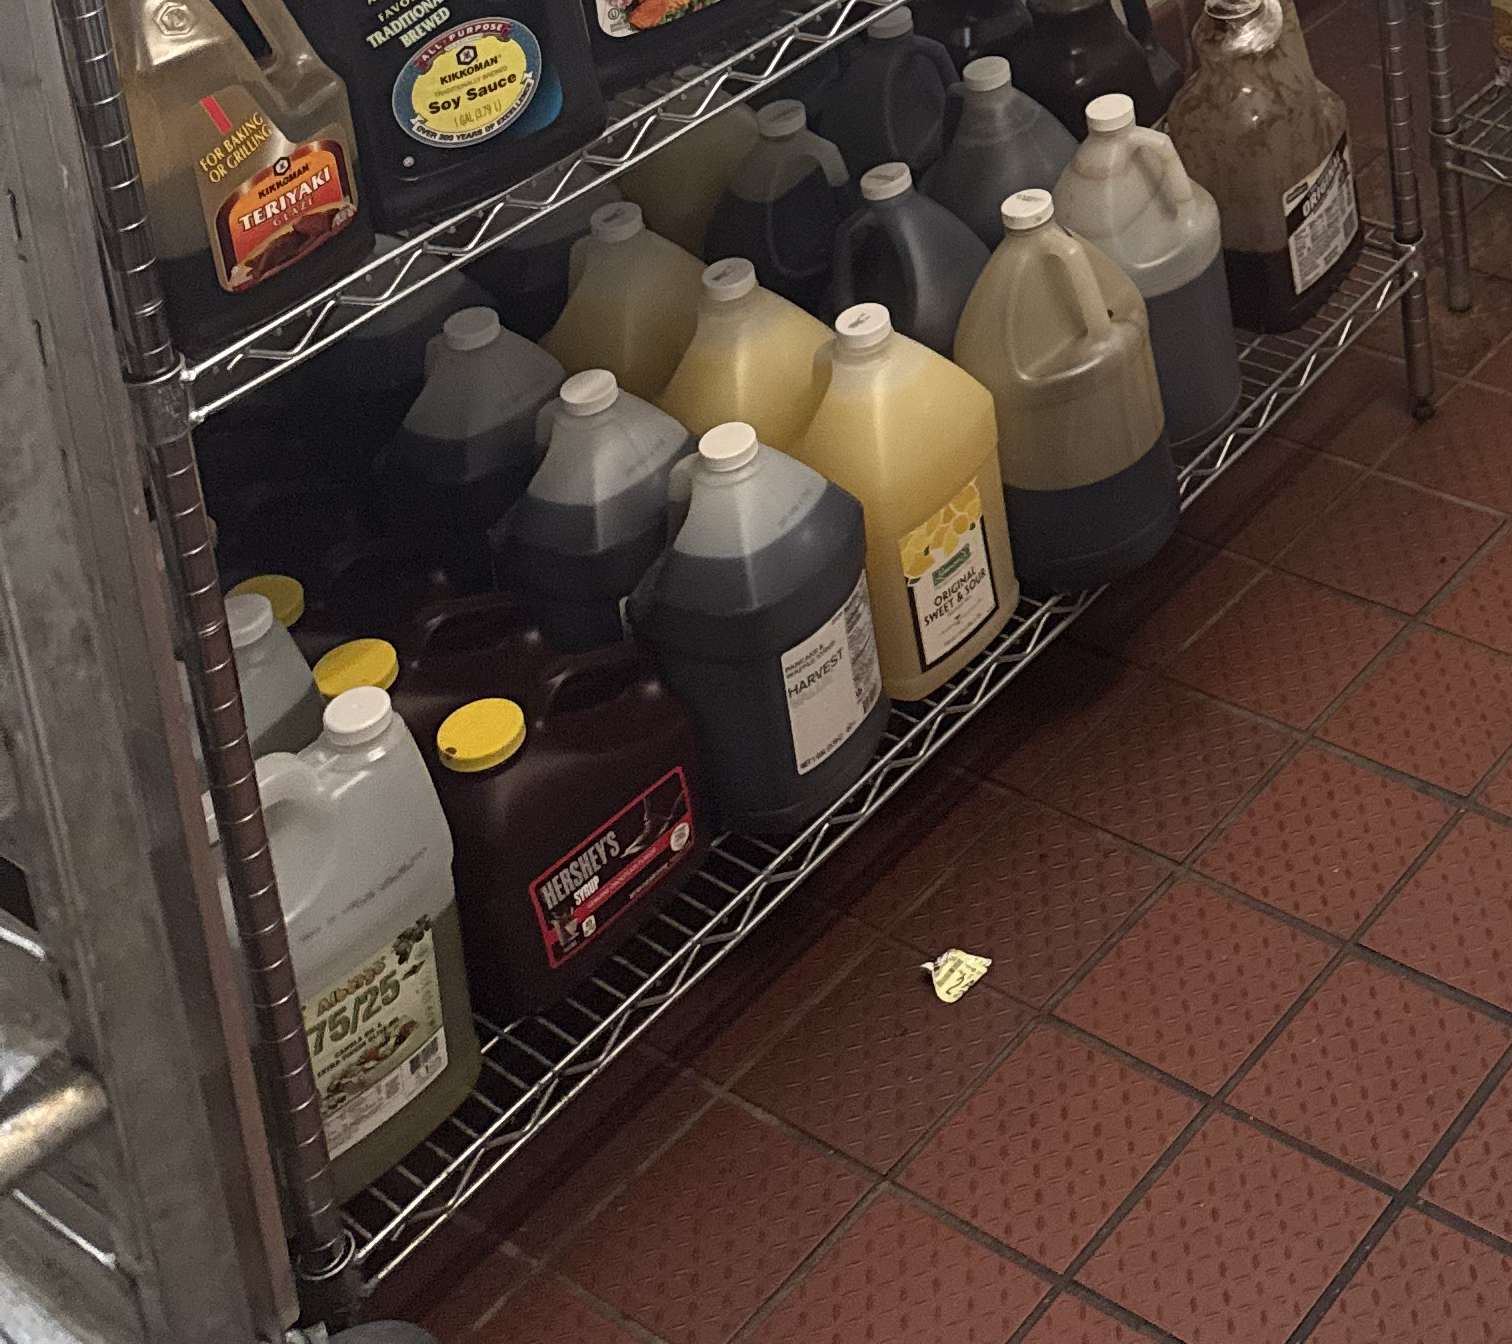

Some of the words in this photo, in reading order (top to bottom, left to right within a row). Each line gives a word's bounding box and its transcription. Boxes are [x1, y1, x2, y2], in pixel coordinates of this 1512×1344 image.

[399, 6, 451, 48] BREWED
[428, 96, 460, 115] Soy
[466, 72, 517, 101] Sauce
[439, 56, 498, 85] KIKKOMAN
[200, 146, 225, 172] FOR
[223, 112, 264, 150] BAKING
[208, 164, 228, 183] OR
[226, 123, 272, 170] GRILLING
[239, 166, 331, 231] TERIYAKI
[258, 163, 310, 199] KIKKOMAN
[924, 599, 955, 627] SWEET
[963, 568, 986, 596] SOUR
[933, 567, 976, 607] ORIGINAL
[787, 649, 844, 699] HARVEST
[539, 830, 620, 911] HERSHEY'S
